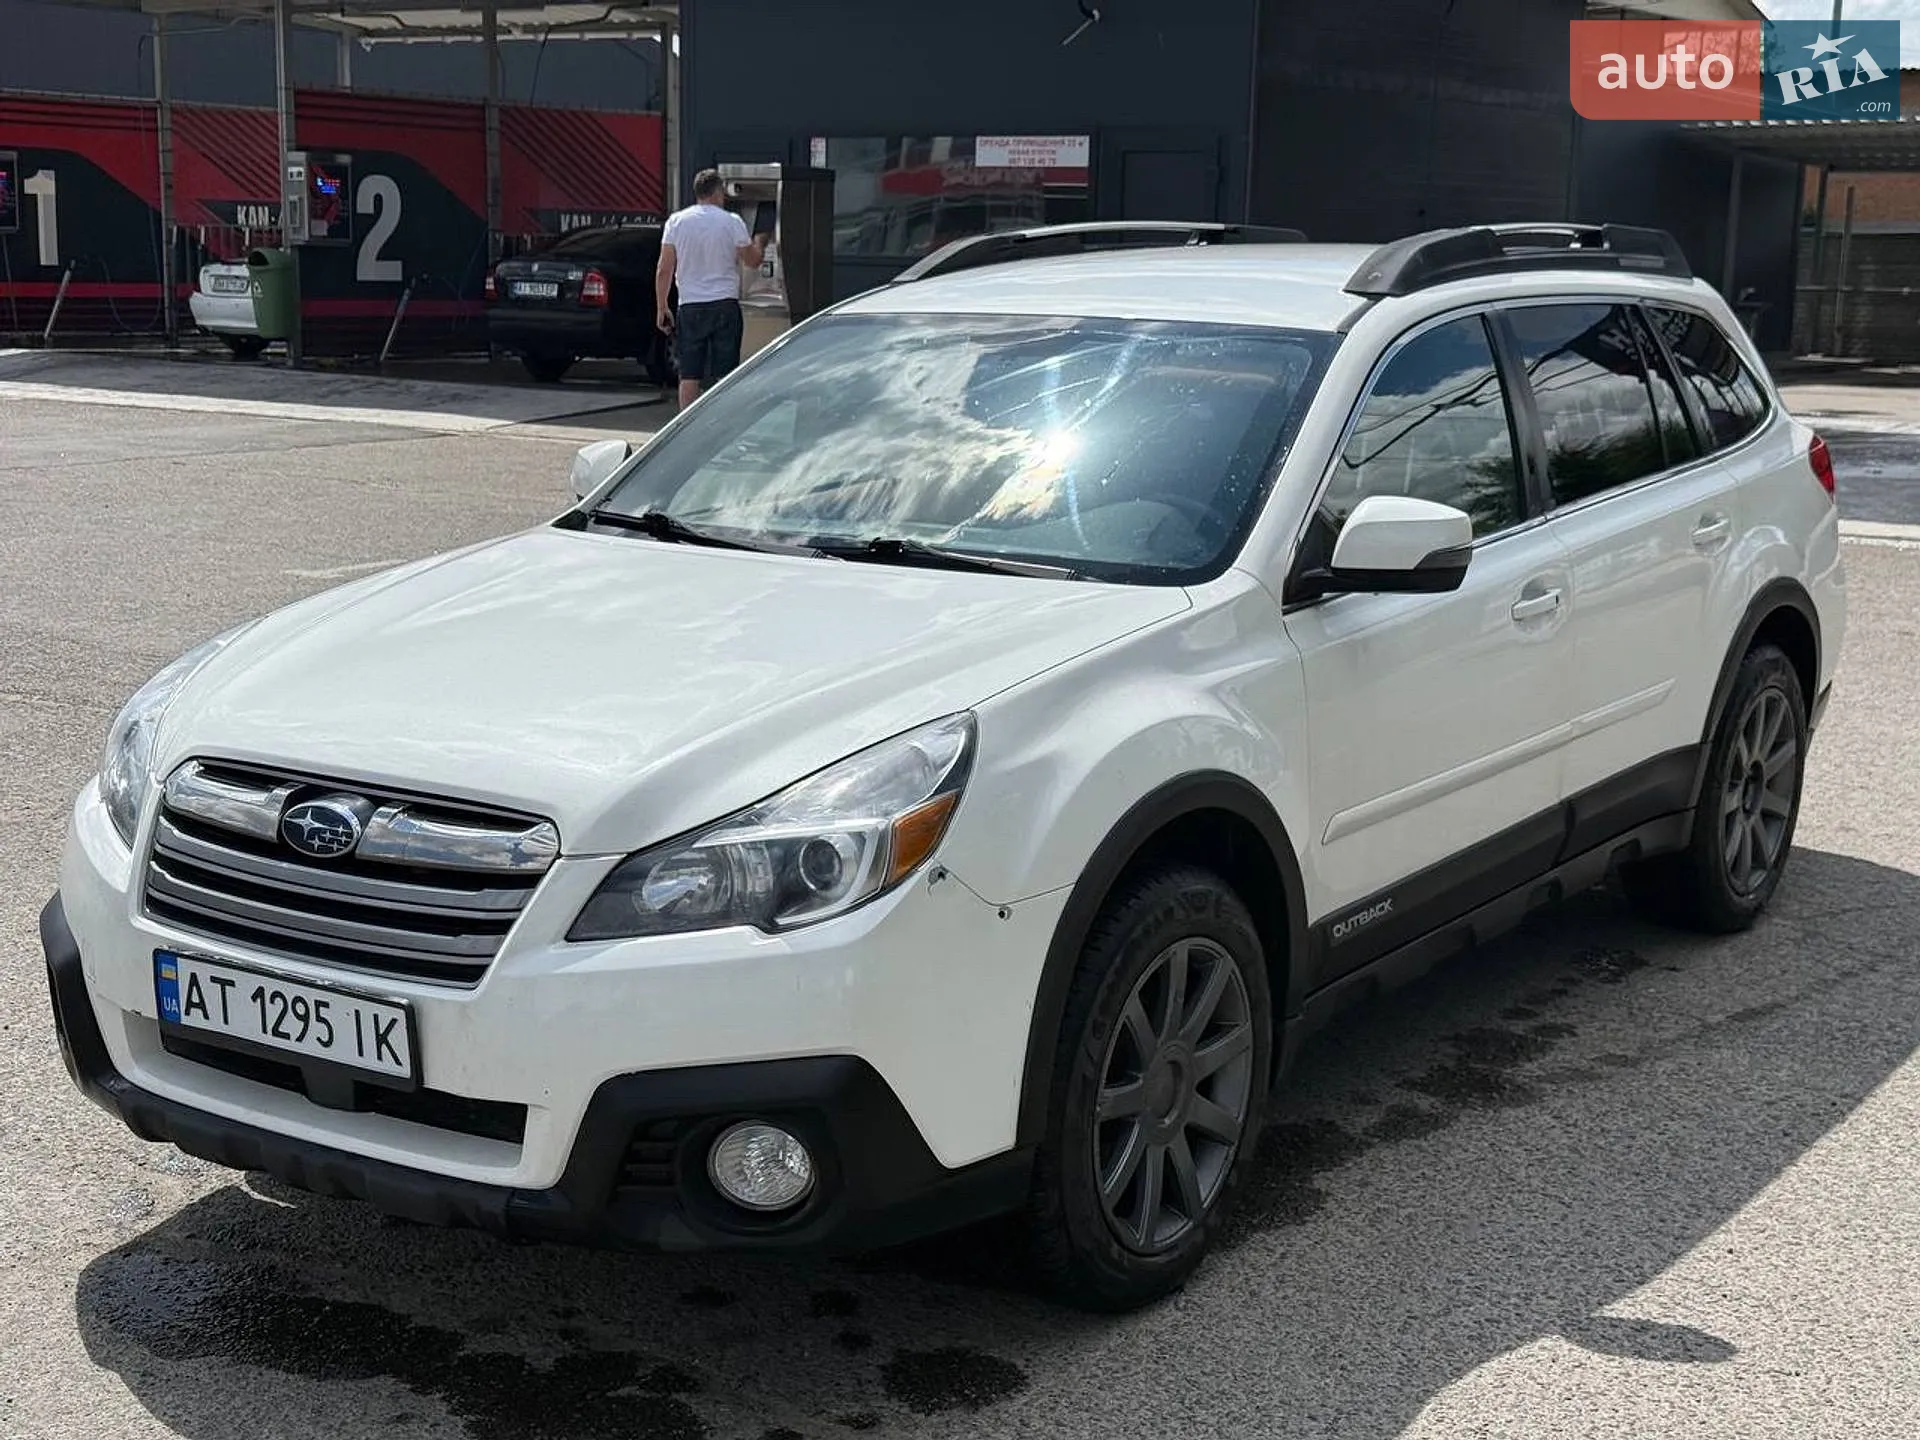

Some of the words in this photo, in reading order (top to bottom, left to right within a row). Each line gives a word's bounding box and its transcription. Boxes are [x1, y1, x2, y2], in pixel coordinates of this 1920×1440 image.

[24, 169, 59, 266] 1
[356, 174, 403, 281] 2
[1332, 898, 1393, 937] OUTBACK
[163, 996, 179, 1013] UA
[184, 971, 236, 1026] AT
[250, 985, 335, 1048] 1295
[354, 1008, 403, 1067] IK
